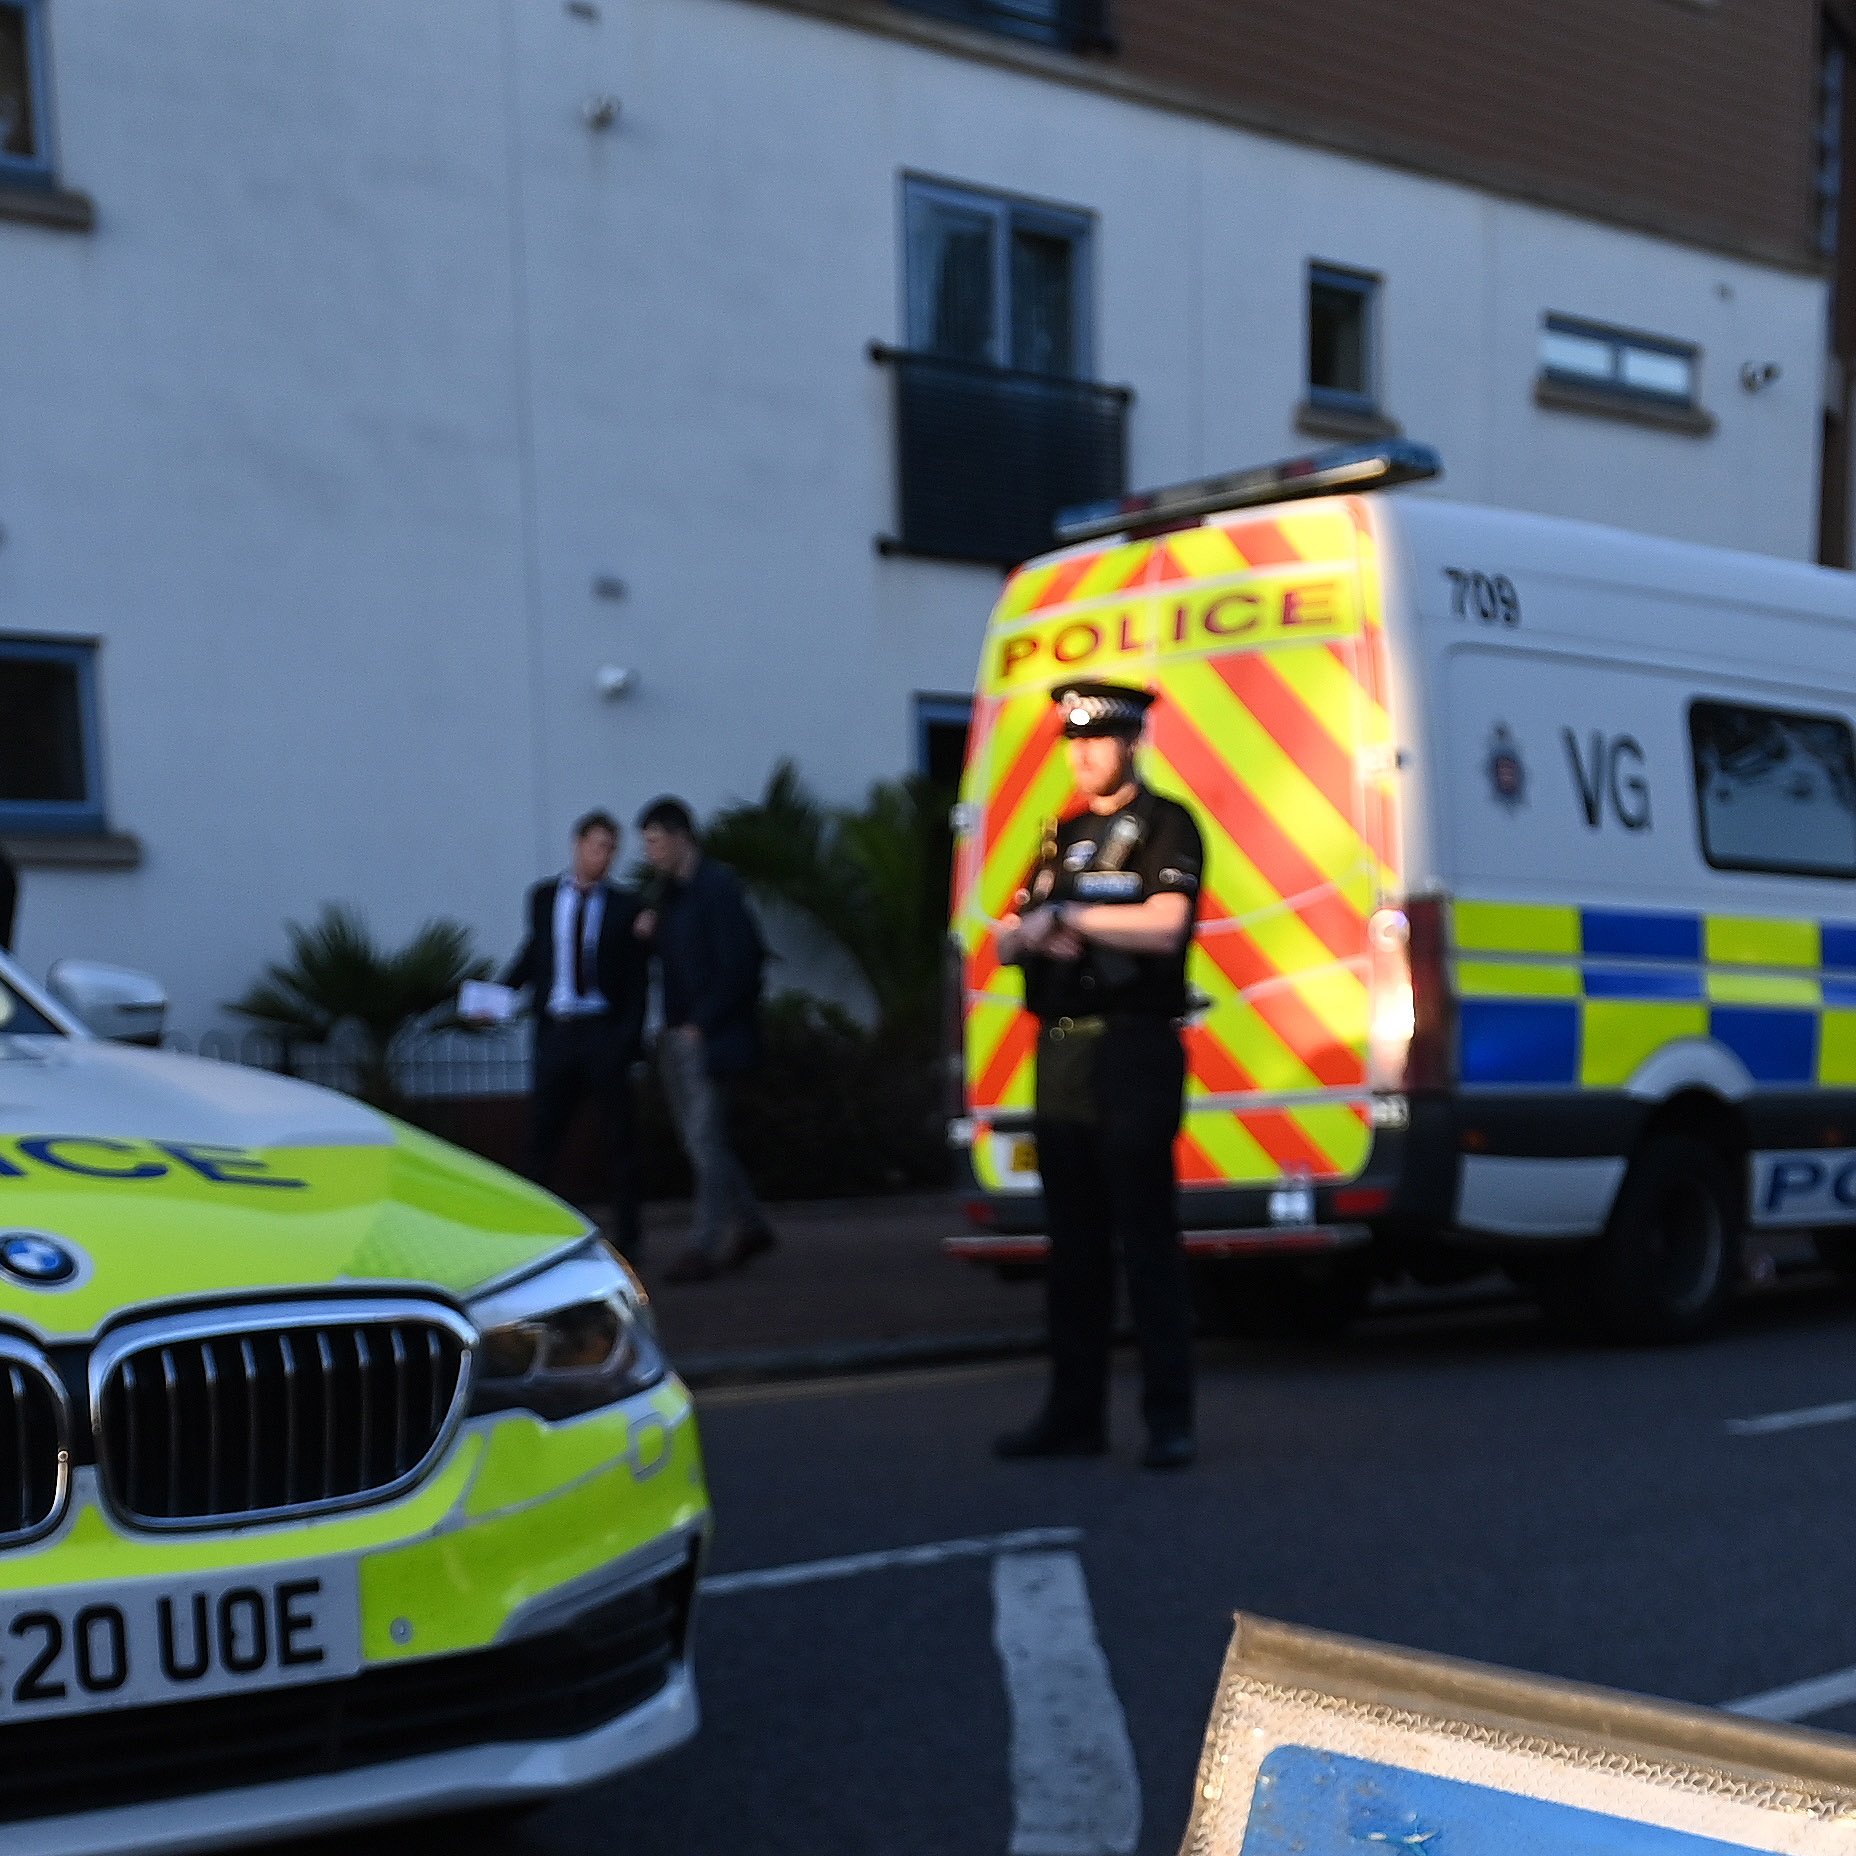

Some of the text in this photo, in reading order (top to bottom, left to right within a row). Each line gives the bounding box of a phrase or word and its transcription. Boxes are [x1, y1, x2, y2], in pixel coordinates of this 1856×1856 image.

[1001, 579, 1336, 680] POLICE
[1444, 567, 1520, 627] 709
[1560, 726, 1652, 830] VG
[156, 1577, 326, 1682] UOE
